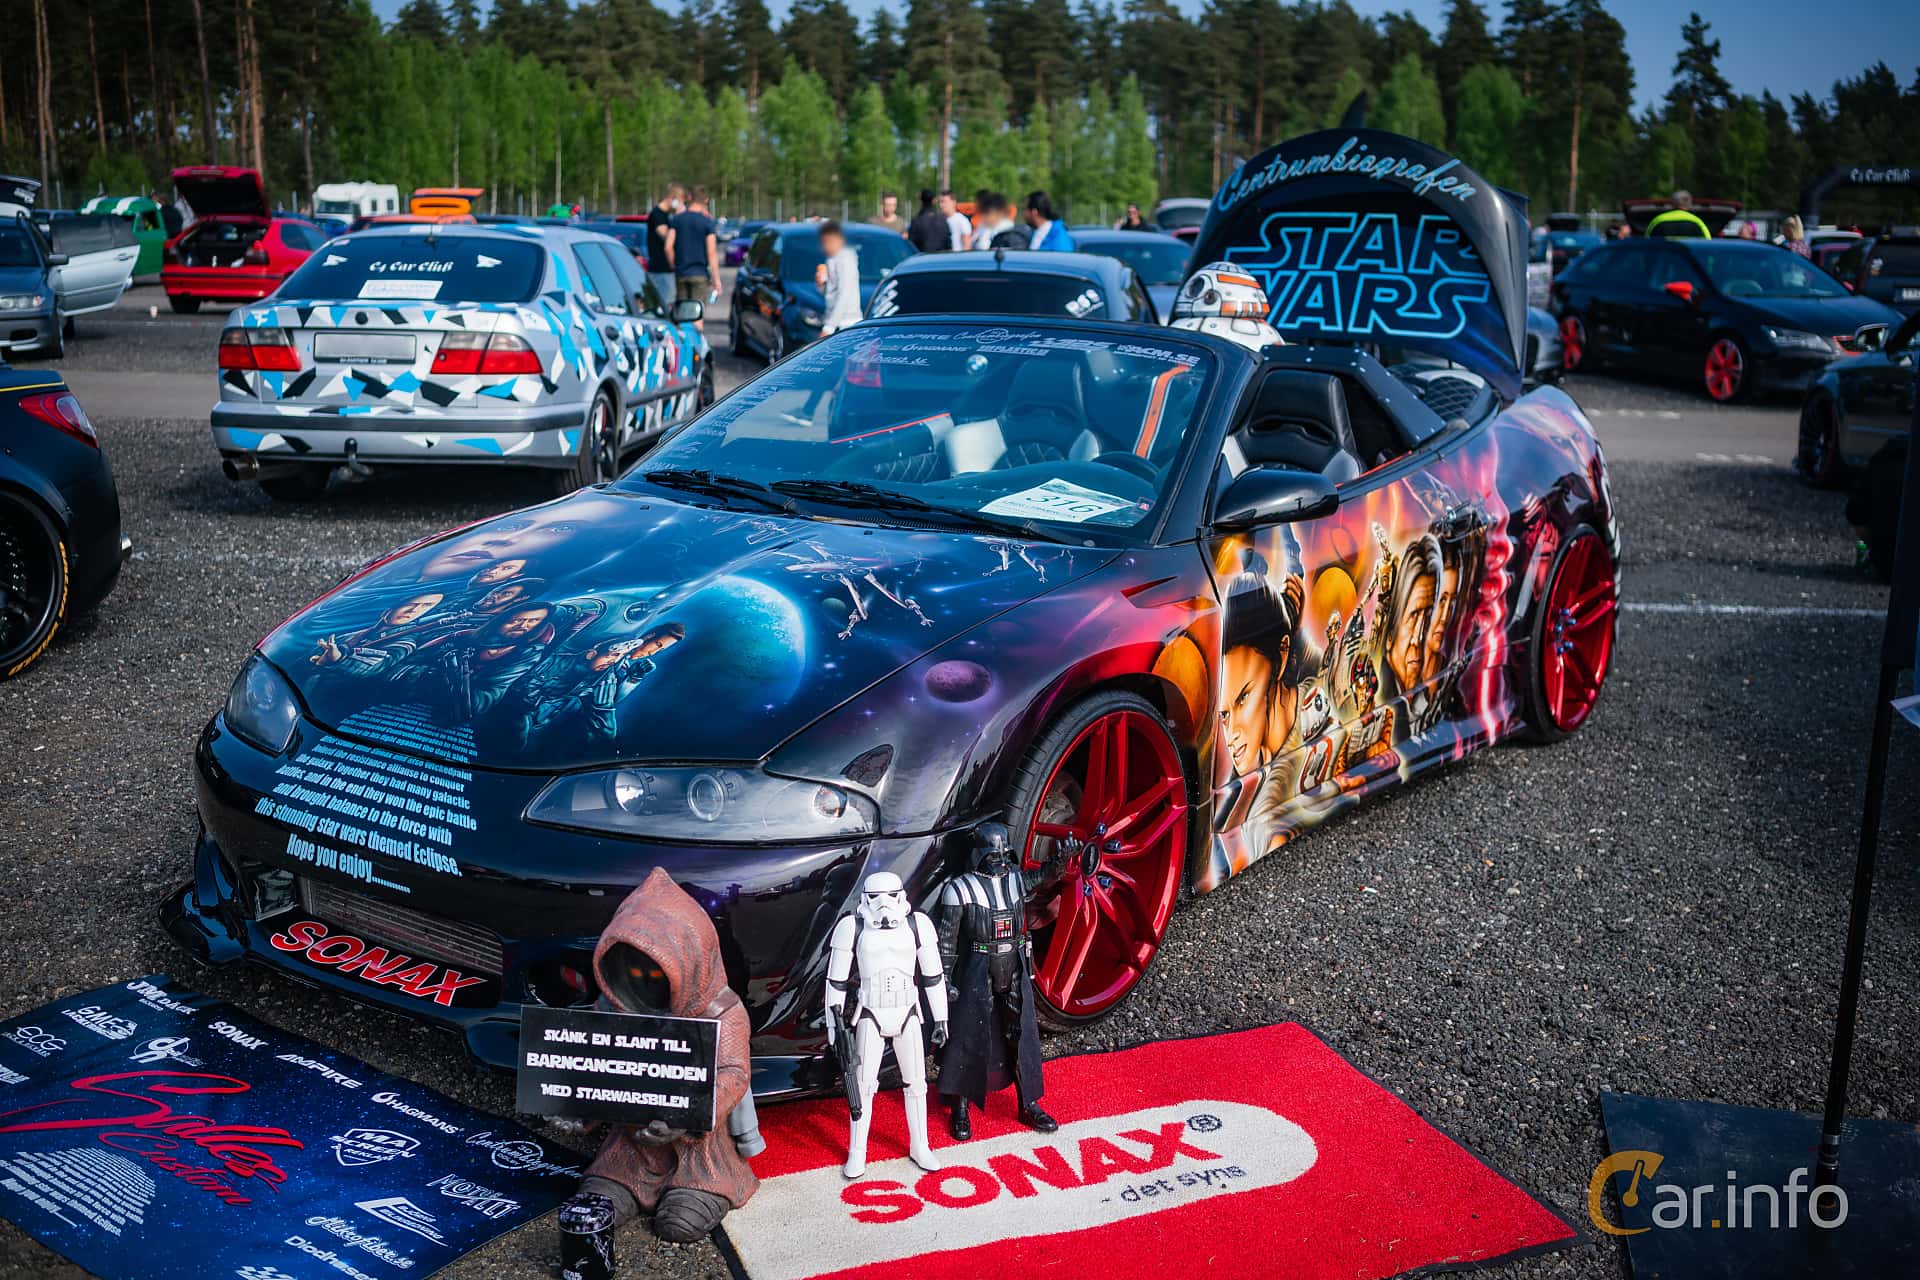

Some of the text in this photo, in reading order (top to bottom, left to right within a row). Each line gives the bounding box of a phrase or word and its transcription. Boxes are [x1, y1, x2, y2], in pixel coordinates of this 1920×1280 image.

[1217, 136, 1477, 211] Centrumbiografen
[1865, 168, 1884, 182] Car
[1224, 211, 1489, 279] STAR
[389, 261, 417, 272] Car
[417, 260, 454, 273] Club
[333, 760, 371, 782] Together
[370, 769, 390, 787] they
[389, 774, 408, 791] had
[407, 780, 433, 799] many
[432, 787, 472, 810] galactic
[345, 750, 387, 771] resistance
[428, 772, 465, 793] conquer
[273, 780, 453, 847] and brought balance to the force with
[303, 769, 322, 786] and
[329, 775, 346, 791] the
[345, 778, 365, 796] end
[363, 784, 386, 805] they
[385, 791, 406, 809] won
[405, 795, 423, 814] the
[423, 801, 446, 822] epic
[446, 808, 478, 831] battle
[254, 796, 464, 878] this stunning star wars themed Eclipse.
[286, 832, 315, 862] Hope
[314, 844, 338, 870] you
[270, 920, 488, 1007] SONAX
[207, 1020, 270, 1051] SONAX
[591, 1033, 611, 1046] EN
[614, 1034, 659, 1051] SLANT
[661, 1039, 692, 1054] TILL
[275, 1053, 364, 1090] AMPIRE
[526, 1051, 708, 1083] BARNCANCERFONDEN
[387, 1096, 459, 1135] HAGMANS
[540, 1083, 690, 1109] MED STARWARSBILEN
[328, 1134, 416, 1159] SCREEN
[356, 1131, 407, 1149] MA
[99, 1131, 252, 1206] Custom
[838, 1120, 1225, 1225] SONAX
[1120, 1177, 1175, 1205] det
[1177, 1163, 1247, 1191] syns
